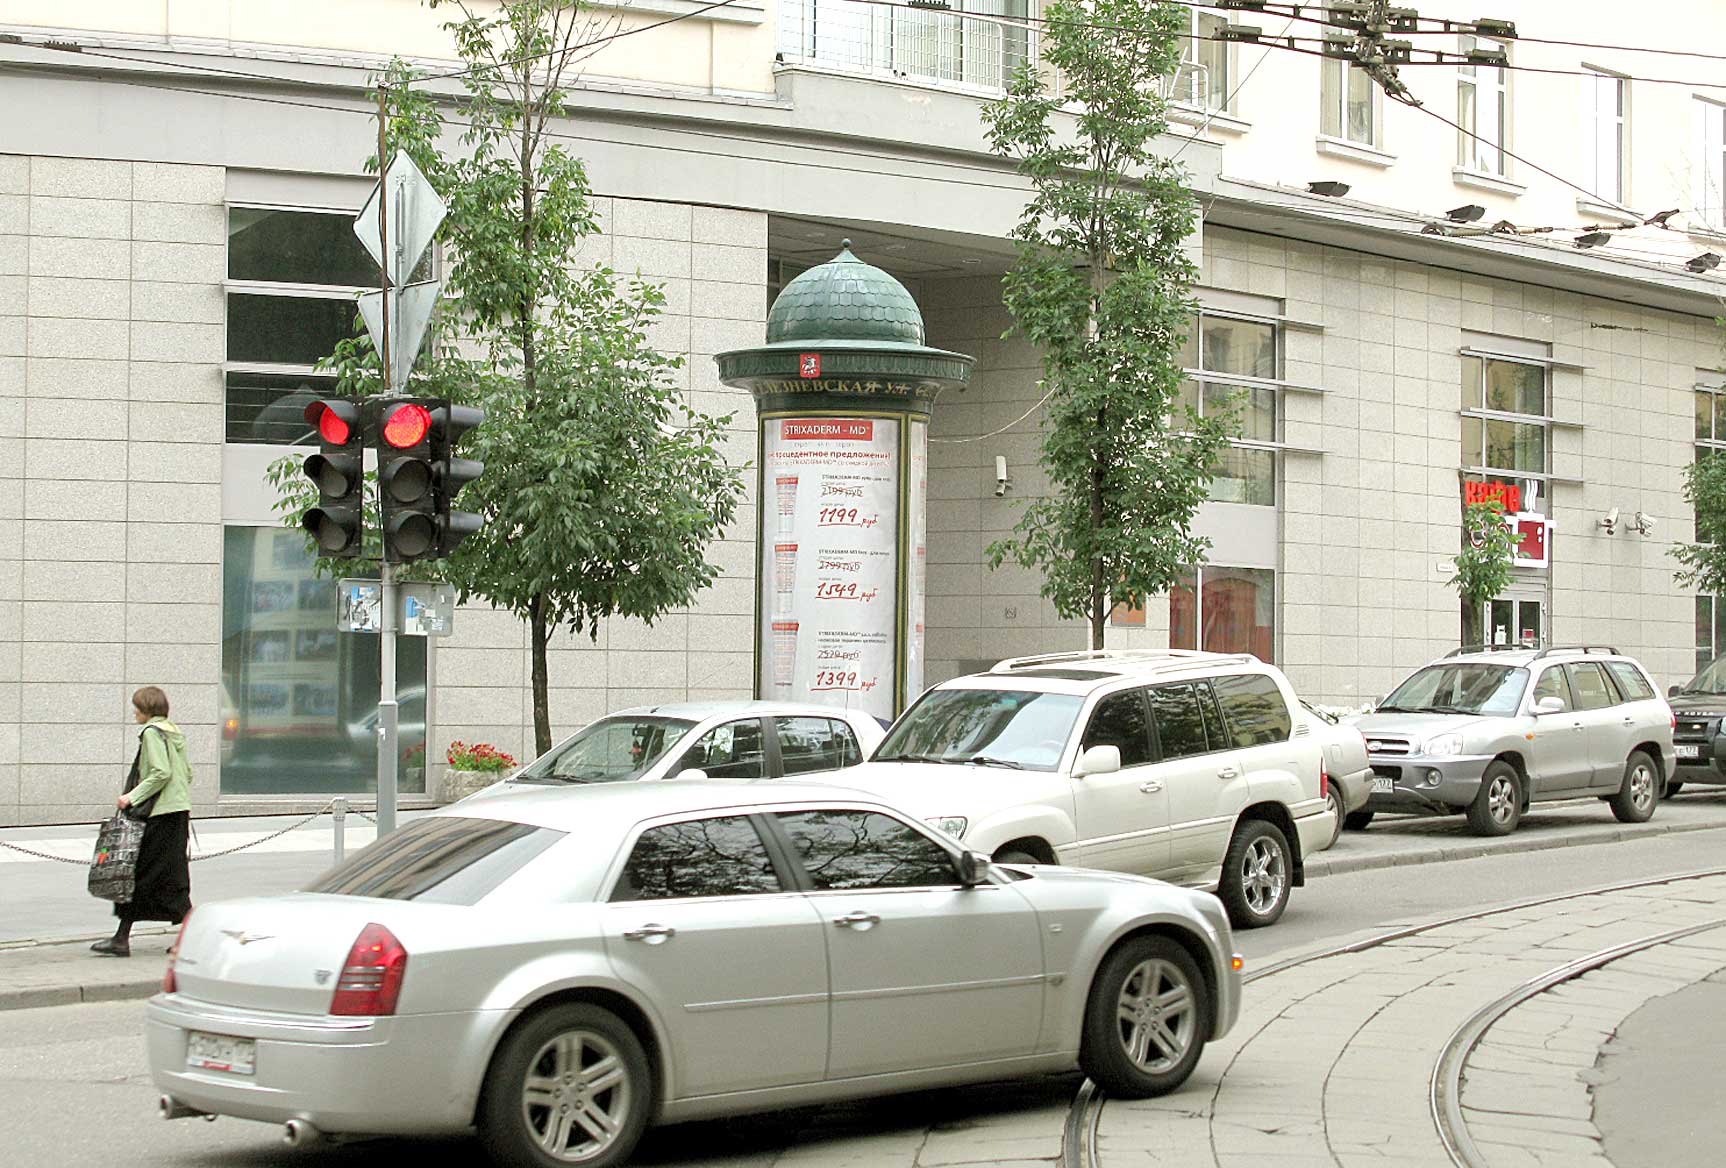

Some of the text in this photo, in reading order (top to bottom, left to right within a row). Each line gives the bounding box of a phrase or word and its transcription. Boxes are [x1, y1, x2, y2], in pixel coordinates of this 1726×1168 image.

[785, 425, 841, 435] STRIXADERM
[819, 508, 858, 523] 1199
[817, 582, 857, 597] 1549
[817, 671, 857, 686] 1399
